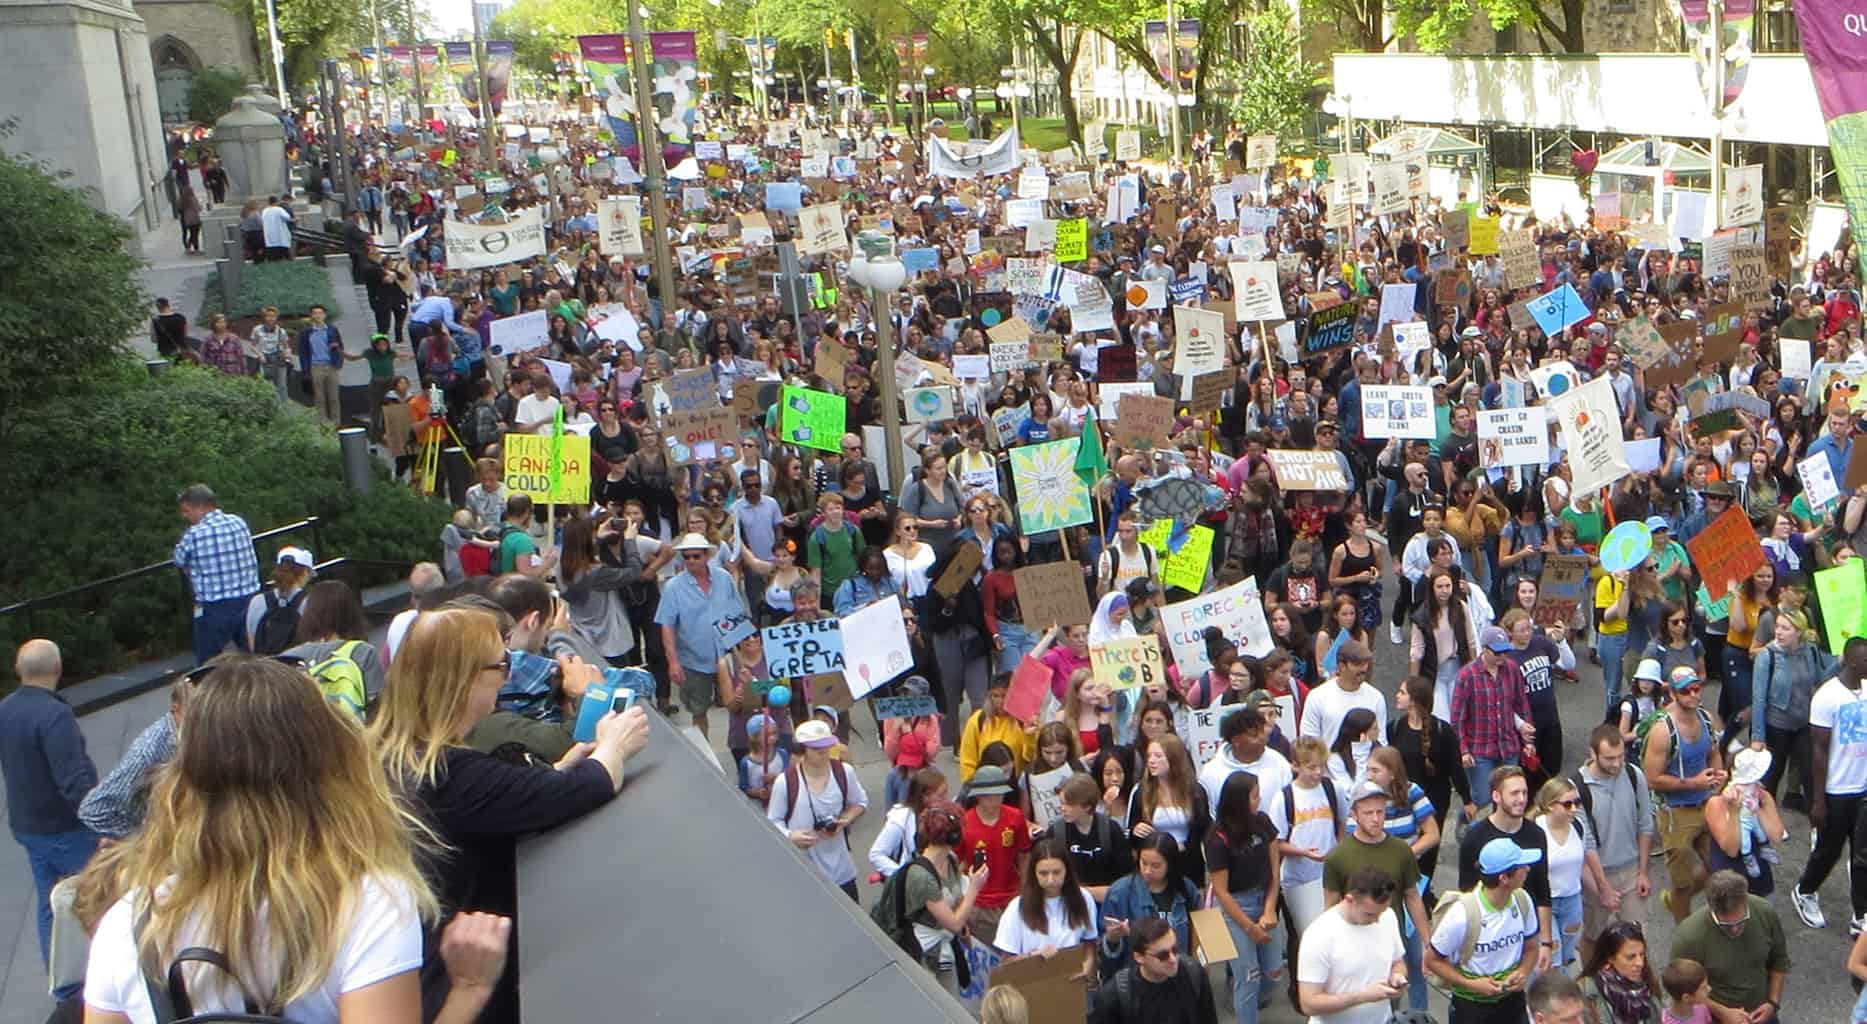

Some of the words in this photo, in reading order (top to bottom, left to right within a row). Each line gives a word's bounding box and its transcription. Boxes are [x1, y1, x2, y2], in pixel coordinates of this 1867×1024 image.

[1737, 263, 1761, 279] YOU
[1314, 303, 1356, 328] NATURE
[1366, 390, 1388, 399] LEAVE
[687, 424, 722, 443] ONE!
[1388, 421, 1409, 430] ALONE
[1273, 451, 1337, 464] ENOUGH
[1280, 464, 1312, 481] HOT
[1315, 469, 1347, 489] AIR
[506, 474, 550, 492] COLD
[768, 620, 840, 640] LISTEN
[783, 640, 820, 656] TO
[1091, 645, 1140, 668] There
[1144, 640, 1160, 662] is
[769, 650, 847, 679] GRETA
[1141, 663, 1153, 683] B
[1474, 931, 1524, 953] macron
